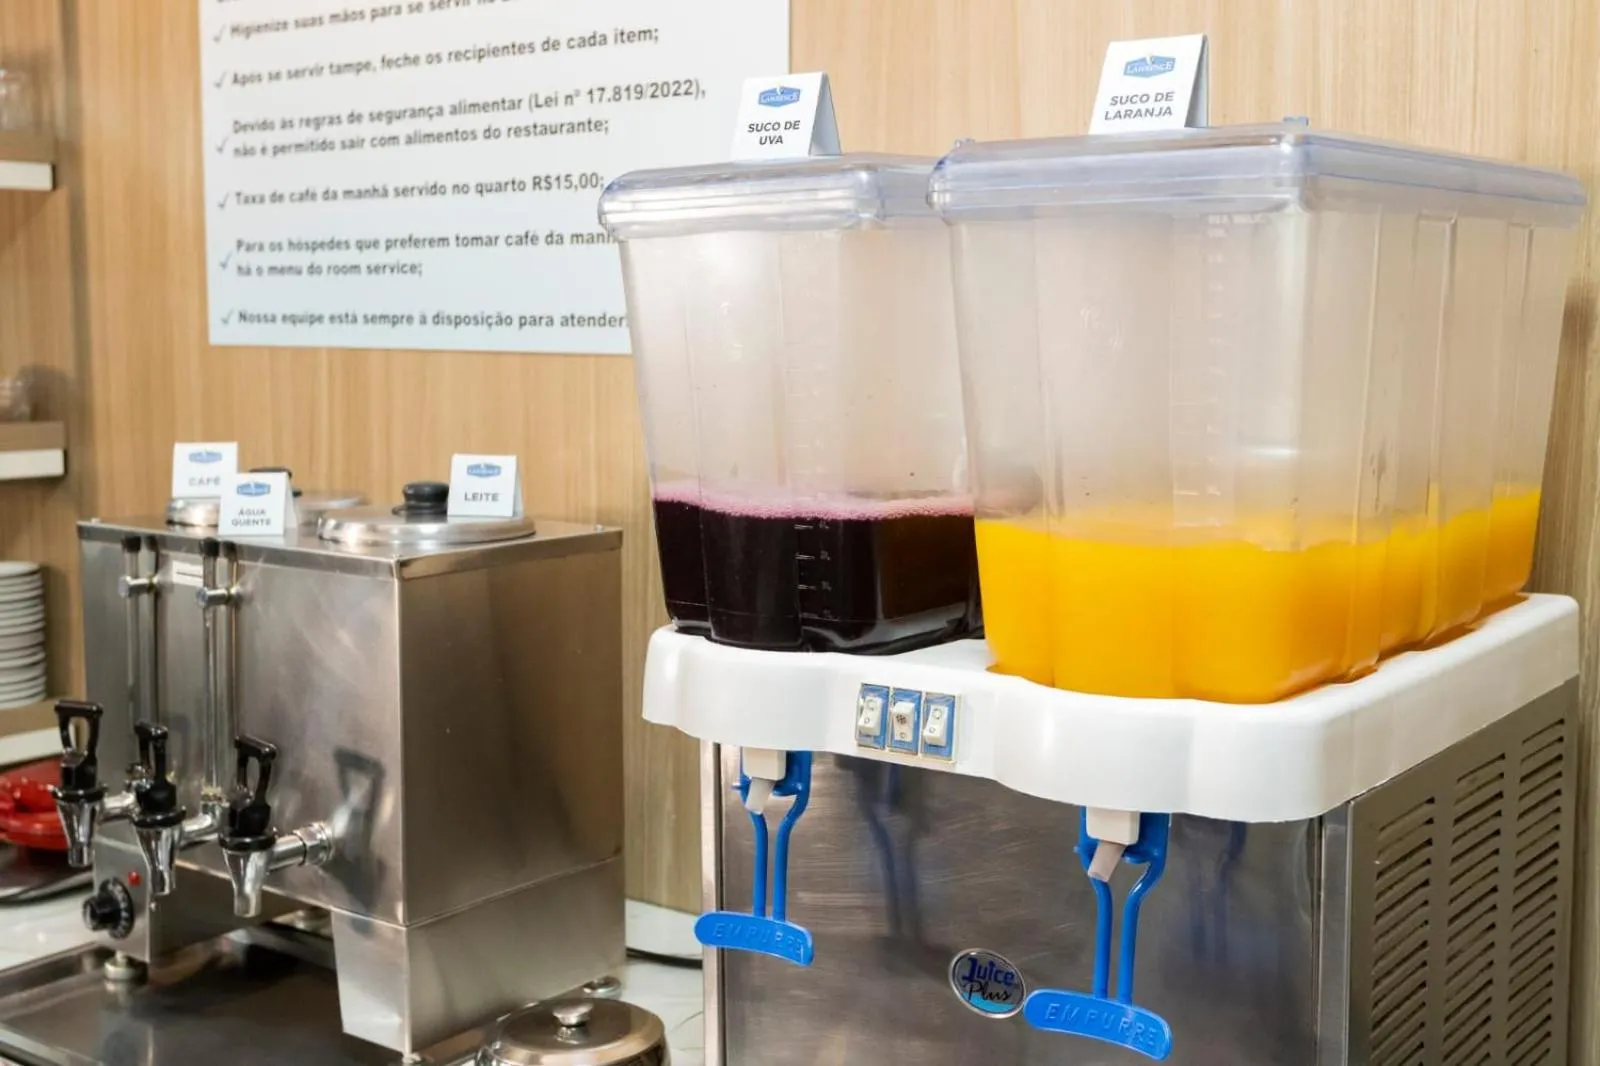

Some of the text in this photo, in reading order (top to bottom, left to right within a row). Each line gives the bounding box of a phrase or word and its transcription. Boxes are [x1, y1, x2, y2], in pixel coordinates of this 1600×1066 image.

[231, 0, 470, 39] Higienize suas mãos para se servir
[232, 29, 658, 86] Após se servir tampe, feche os recipientes de cada item;
[233, 120, 275, 134] Devido
[280, 119, 294, 129] às
[299, 115, 342, 131] regras
[347, 111, 363, 124] de
[369, 106, 444, 125] segurança
[449, 98, 522, 115] alimentar
[529, 94, 558, 111] (Lei
[587, 79, 705, 104] 17.819/2022),
[1110, 91, 1175, 106] SUCO DE
[1105, 107, 1172, 121] LARANJA
[748, 120, 800, 133] SUCO DE
[234, 118, 608, 157] não é permitido sair com alimentos do restaurante;
[759, 135, 783, 145] UVA
[236, 172, 604, 204] Taxa de café da manhã servido no quarto R$15,00;
[236, 240, 264, 252] Para
[269, 242, 283, 252] os
[288, 237, 350, 253] hóspedes
[356, 239, 380, 251] que
[385, 234, 450, 252] preferem
[456, 234, 499, 247] tomar
[505, 231, 539, 246] café
[545, 231, 564, 245] da
[237, 263, 422, 276] há o menu do room service;
[239, 312, 276, 323] Nossa
[281, 314, 324, 326] equipe
[329, 312, 358, 324] está
[363, 314, 414, 328] sempre
[420, 314, 427, 325] à
[432, 312, 513, 329] disposição
[519, 316, 554, 329] para
[189, 476, 221, 486] CAFÉ
[465, 492, 500, 502] LEITE
[239, 508, 266, 516] ÁGUA
[231, 519, 271, 527] QUENTE
[961, 957, 1015, 986] Juice
[968, 980, 1012, 1001] Plus
[1046, 1003, 1156, 1045] EMPURRE
